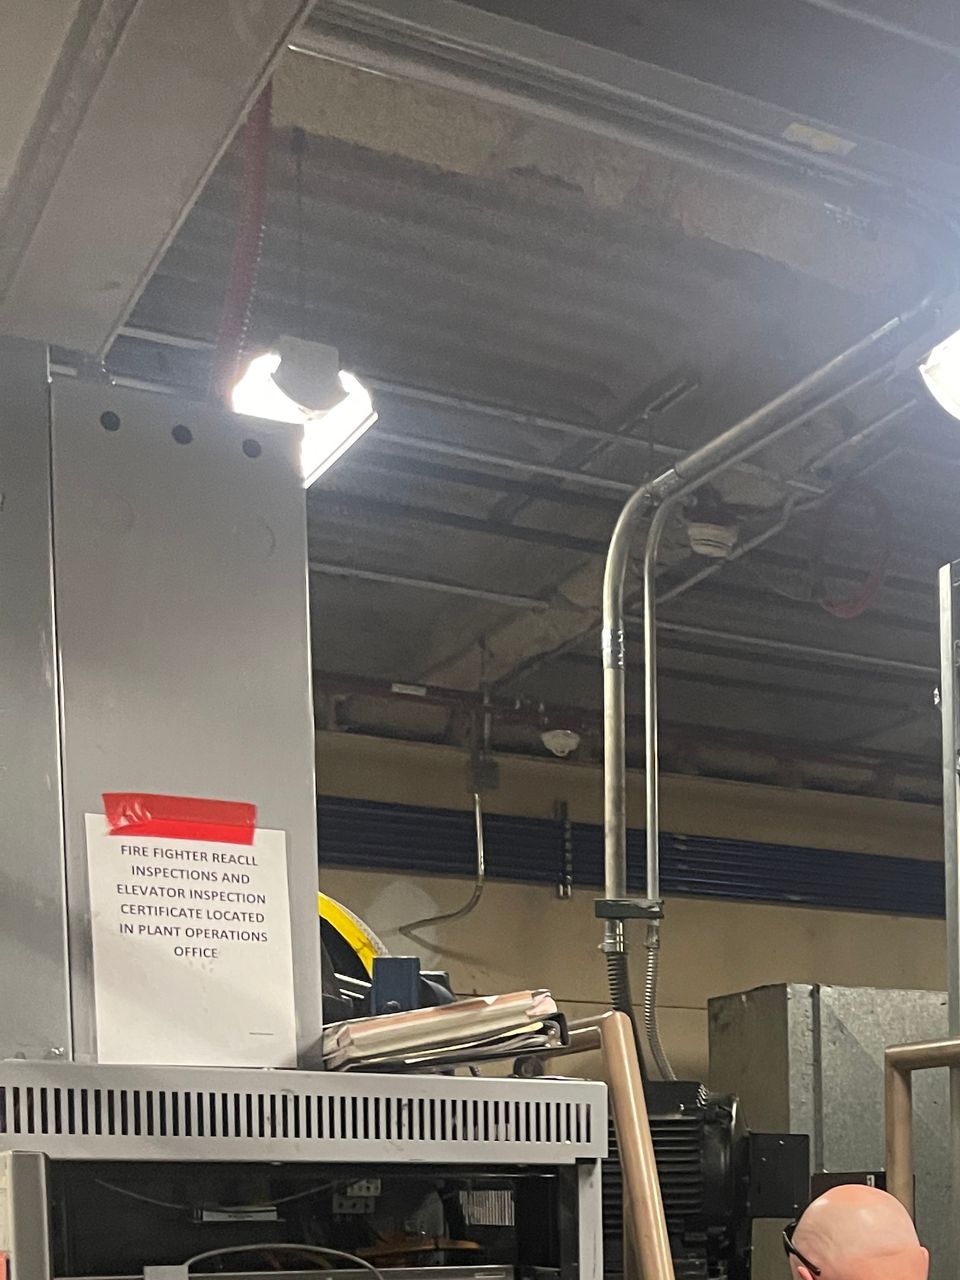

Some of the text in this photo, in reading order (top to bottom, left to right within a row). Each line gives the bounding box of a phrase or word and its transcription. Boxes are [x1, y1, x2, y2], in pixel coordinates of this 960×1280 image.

[120, 844, 259, 866] FIRE FIGHTER REACLL
[131, 865, 251, 884] INSPECTIONS AND
[116, 883, 266, 905] ELEVATOR INSPECTION
[120, 903, 265, 923] CERTIFICATE LOCATED
[119, 923, 268, 942] IN PLANT OPERATIONS
[173, 946, 218, 959] OFFICE
